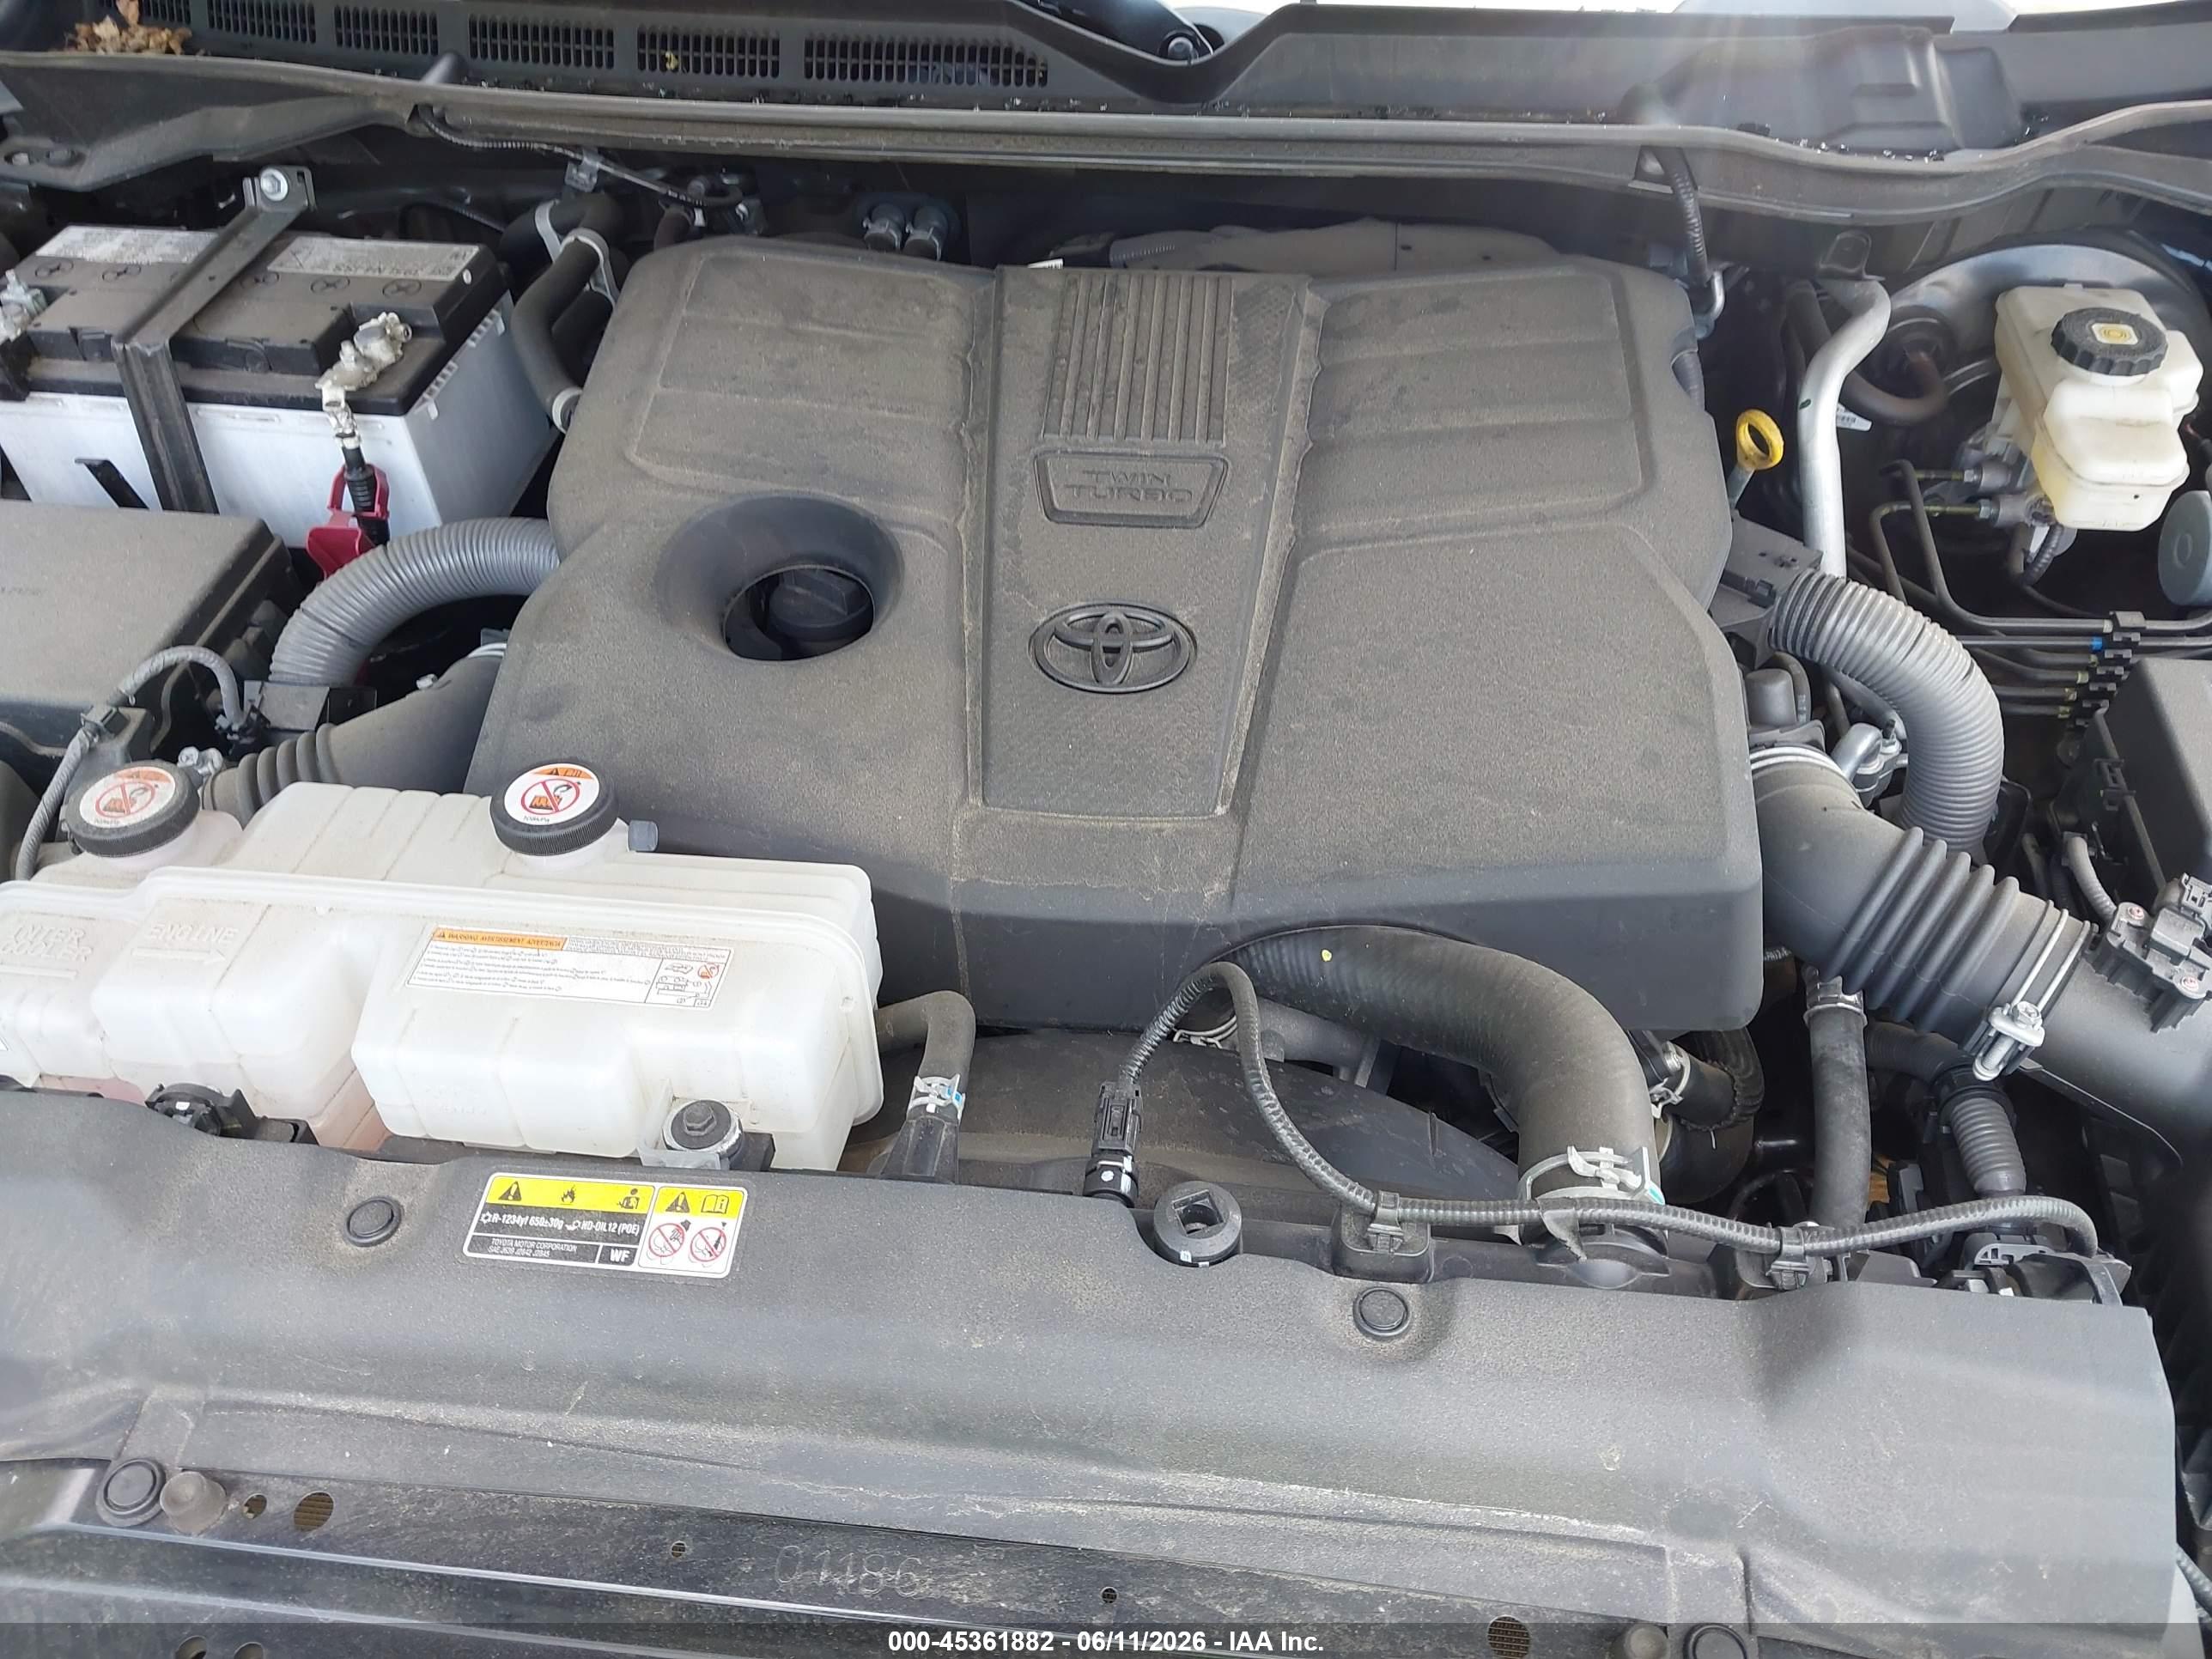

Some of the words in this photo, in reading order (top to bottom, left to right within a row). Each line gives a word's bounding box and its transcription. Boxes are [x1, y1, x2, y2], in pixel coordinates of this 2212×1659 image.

[1082, 469, 1171, 487] TWIN
[1064, 483, 1193, 502] TURBO
[13, 923, 87, 946] INTER
[149, 921, 240, 944] ENGINE
[492, 1212, 529, 1228] R-1234yf
[617, 1222, 641, 1237] (POE)
[488, 1245, 500, 1254] SAE
[491, 1237, 514, 1247] TOYOTA
[514, 1239, 536, 1249] MOTOR
[536, 1242, 577, 1253] CORPORATION
[610, 1248, 630, 1262] WF
